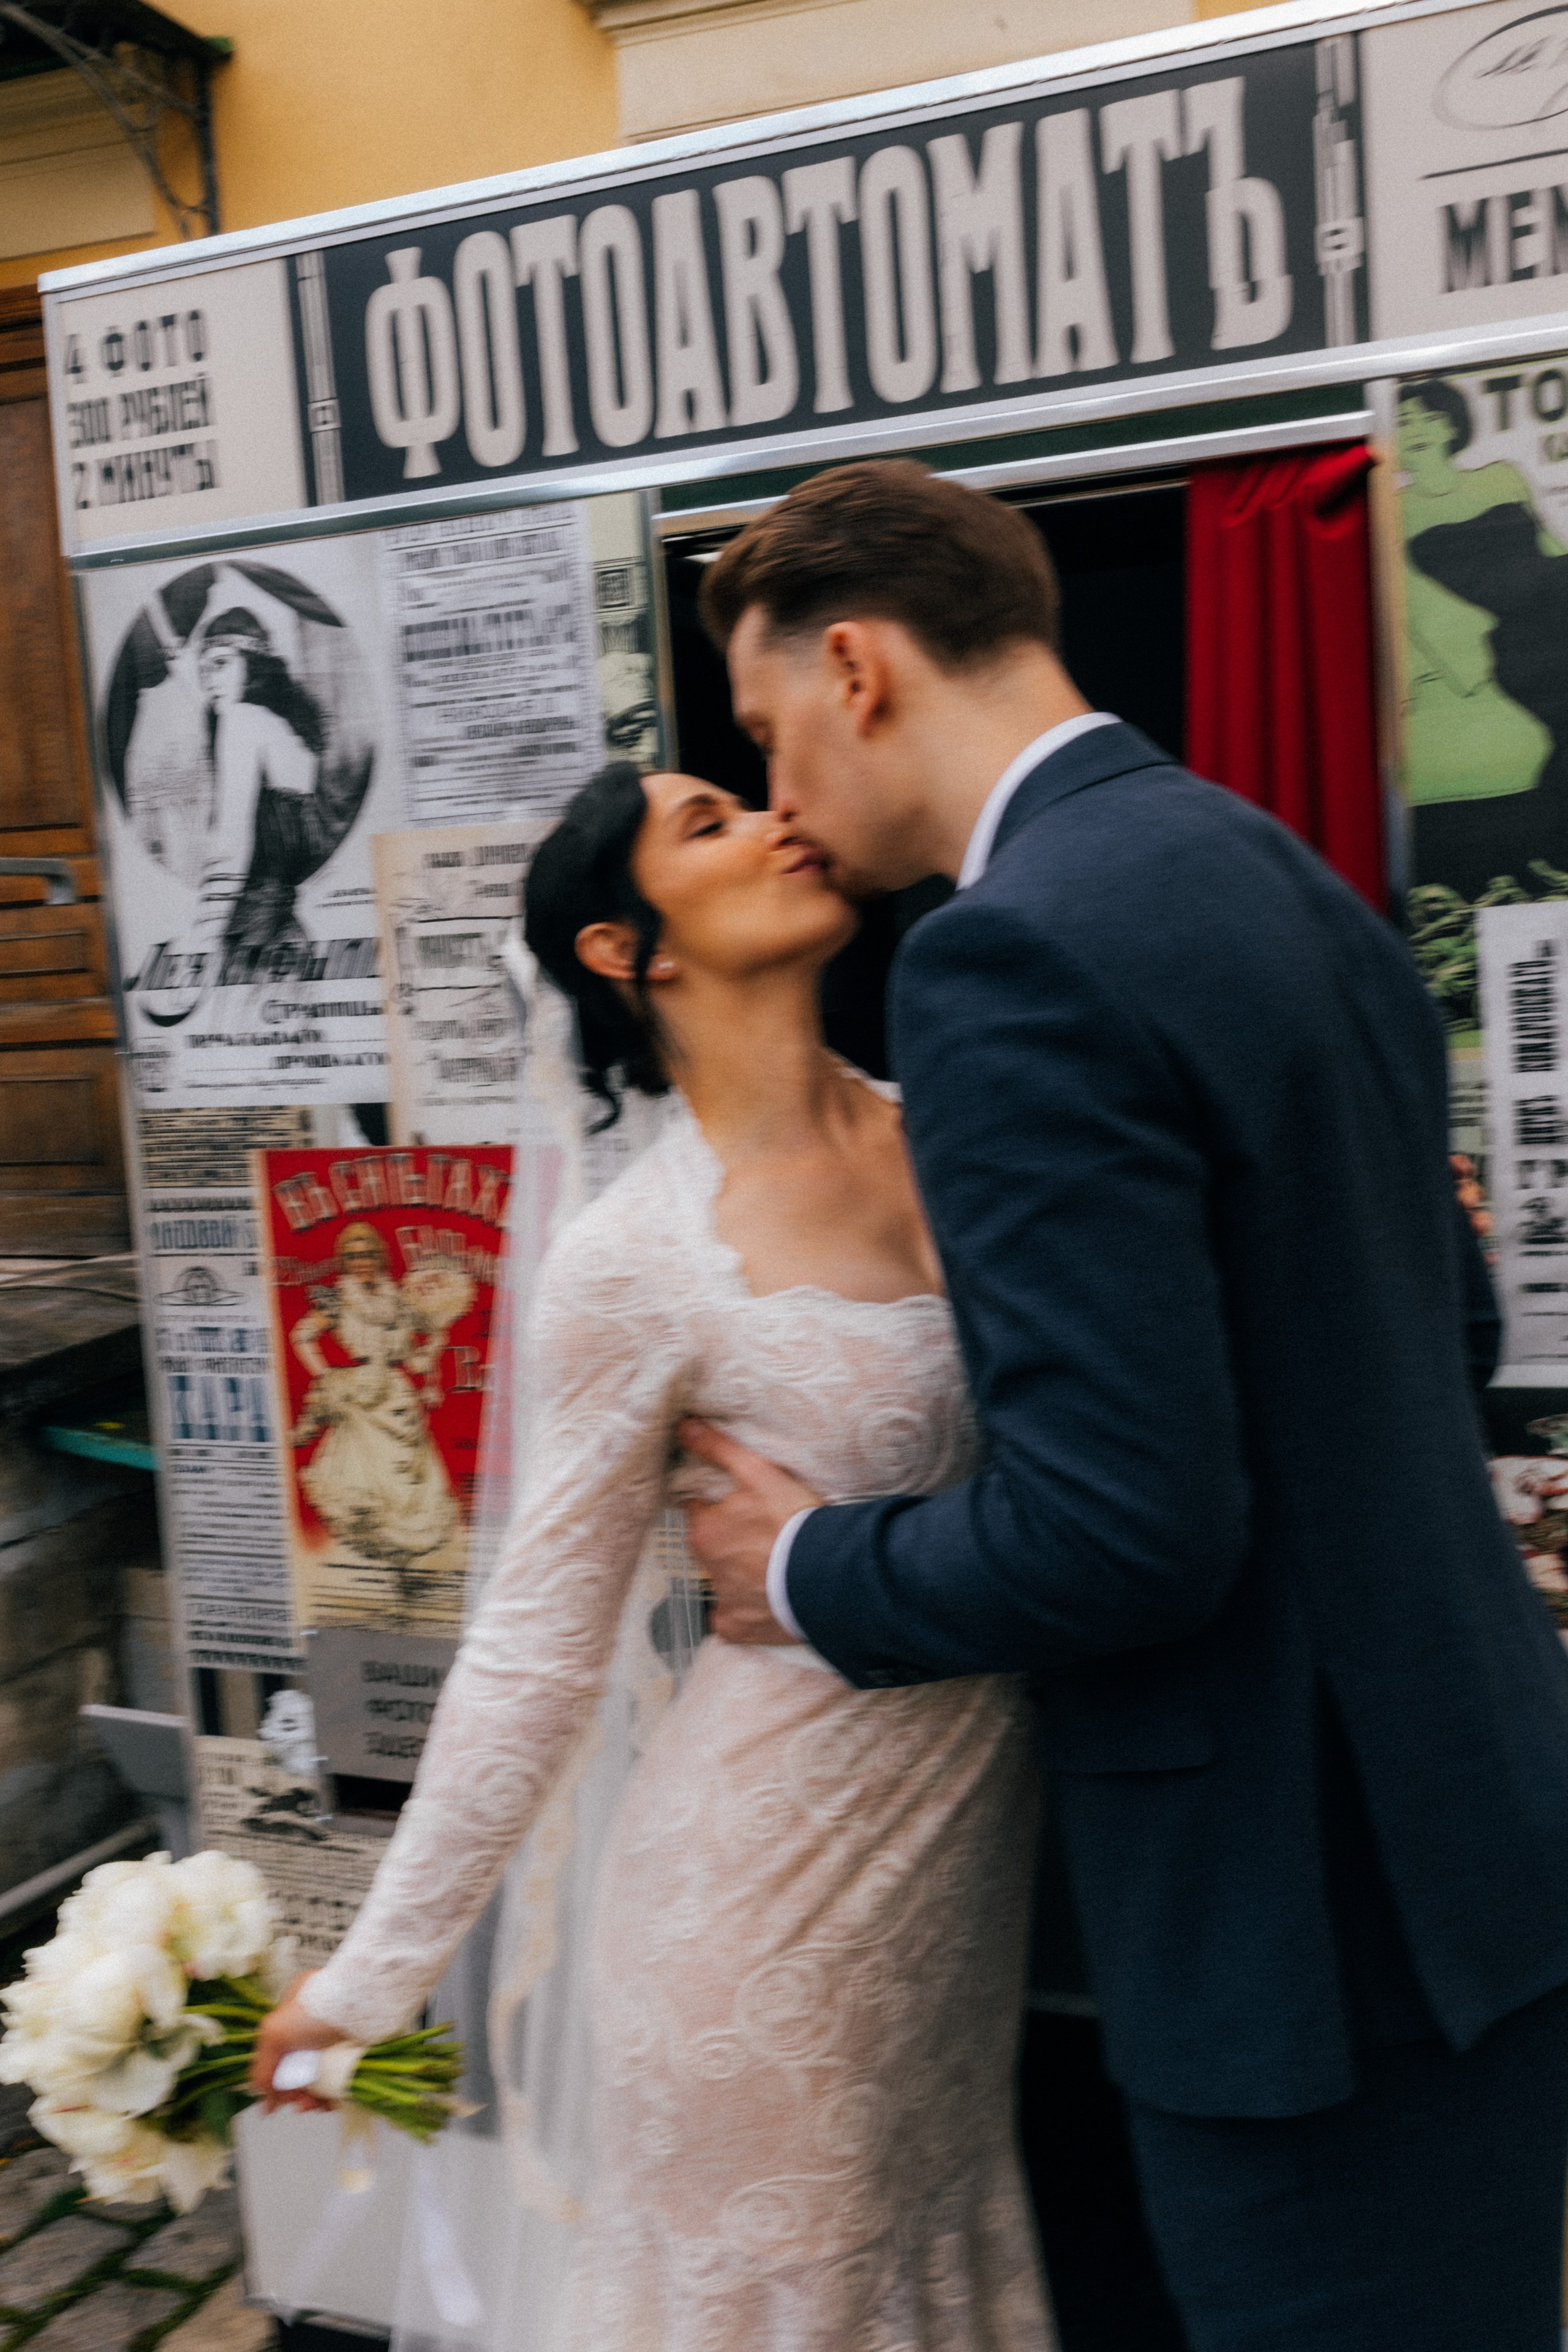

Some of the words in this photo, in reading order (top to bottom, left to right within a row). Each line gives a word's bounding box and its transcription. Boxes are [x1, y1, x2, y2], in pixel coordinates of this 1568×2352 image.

[66, 334, 87, 384] 4
[100, 309, 209, 378] ФОТО
[364, 74, 1294, 480] ФОТОАВТОМАТЪ
